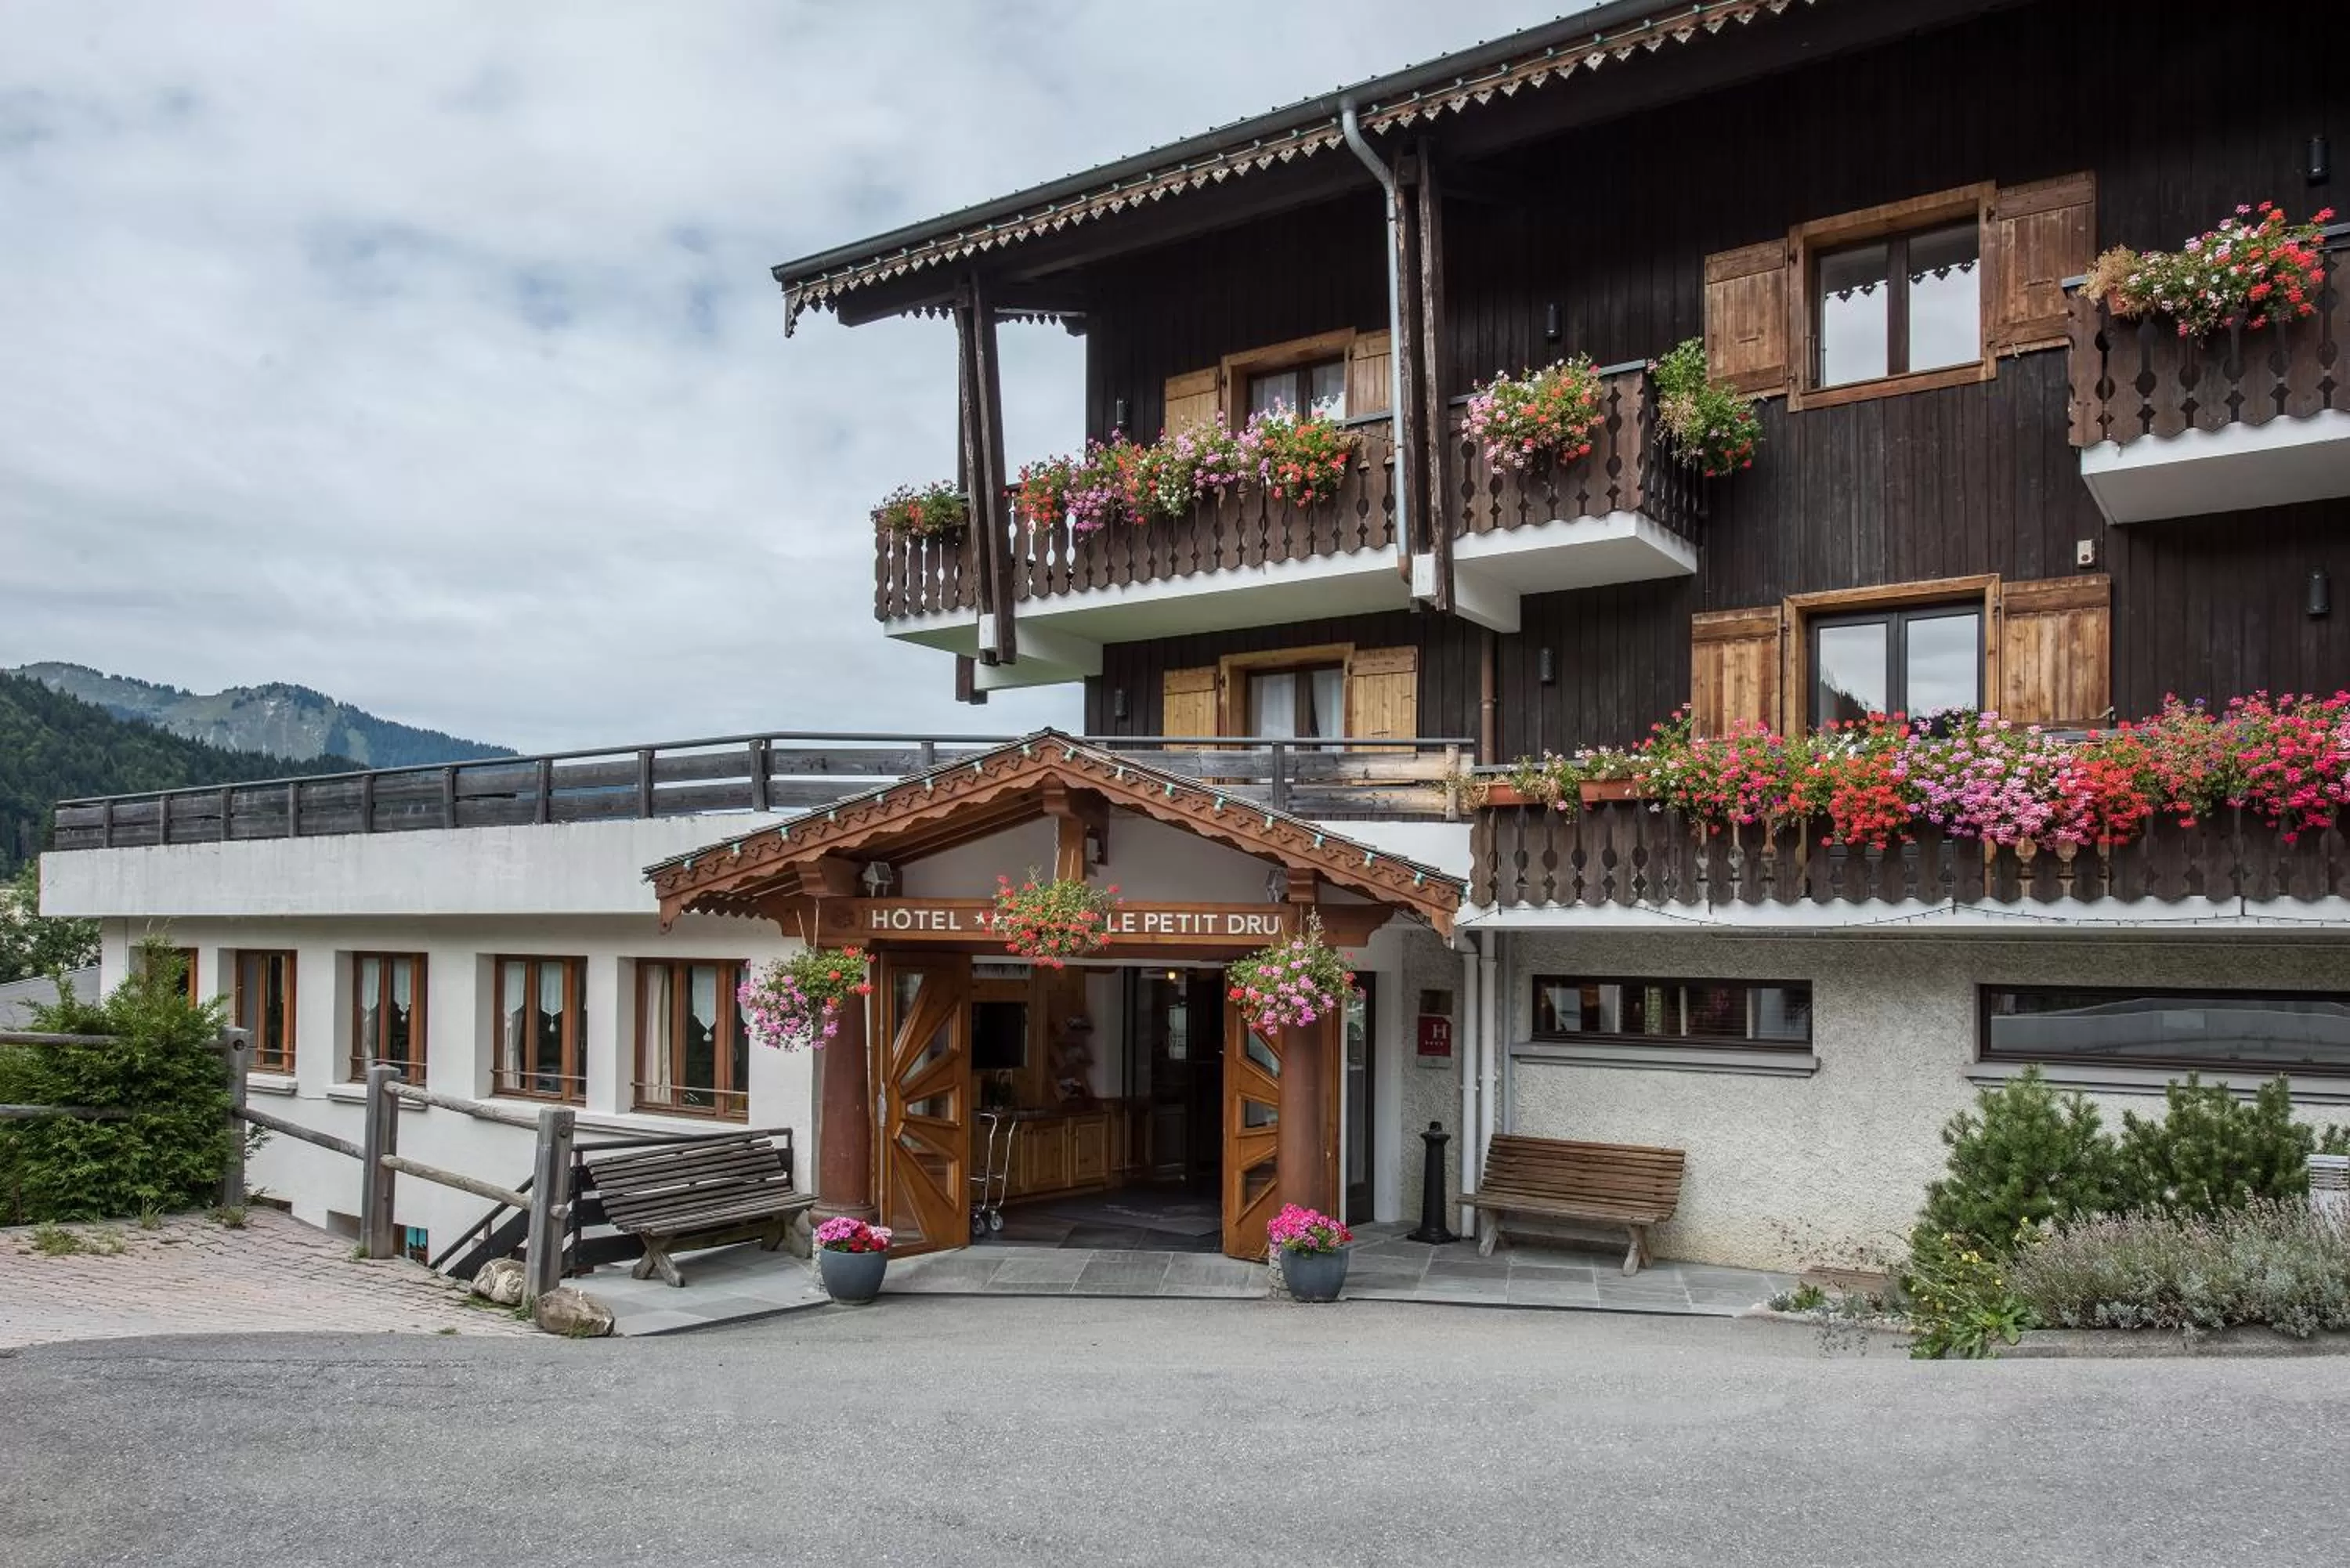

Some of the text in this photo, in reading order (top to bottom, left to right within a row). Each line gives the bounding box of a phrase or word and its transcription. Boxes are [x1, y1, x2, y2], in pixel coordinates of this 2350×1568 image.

[872, 909, 1279, 934] HÔTEL LE PETIT DRU
[1432, 1024, 1448, 1039] H
